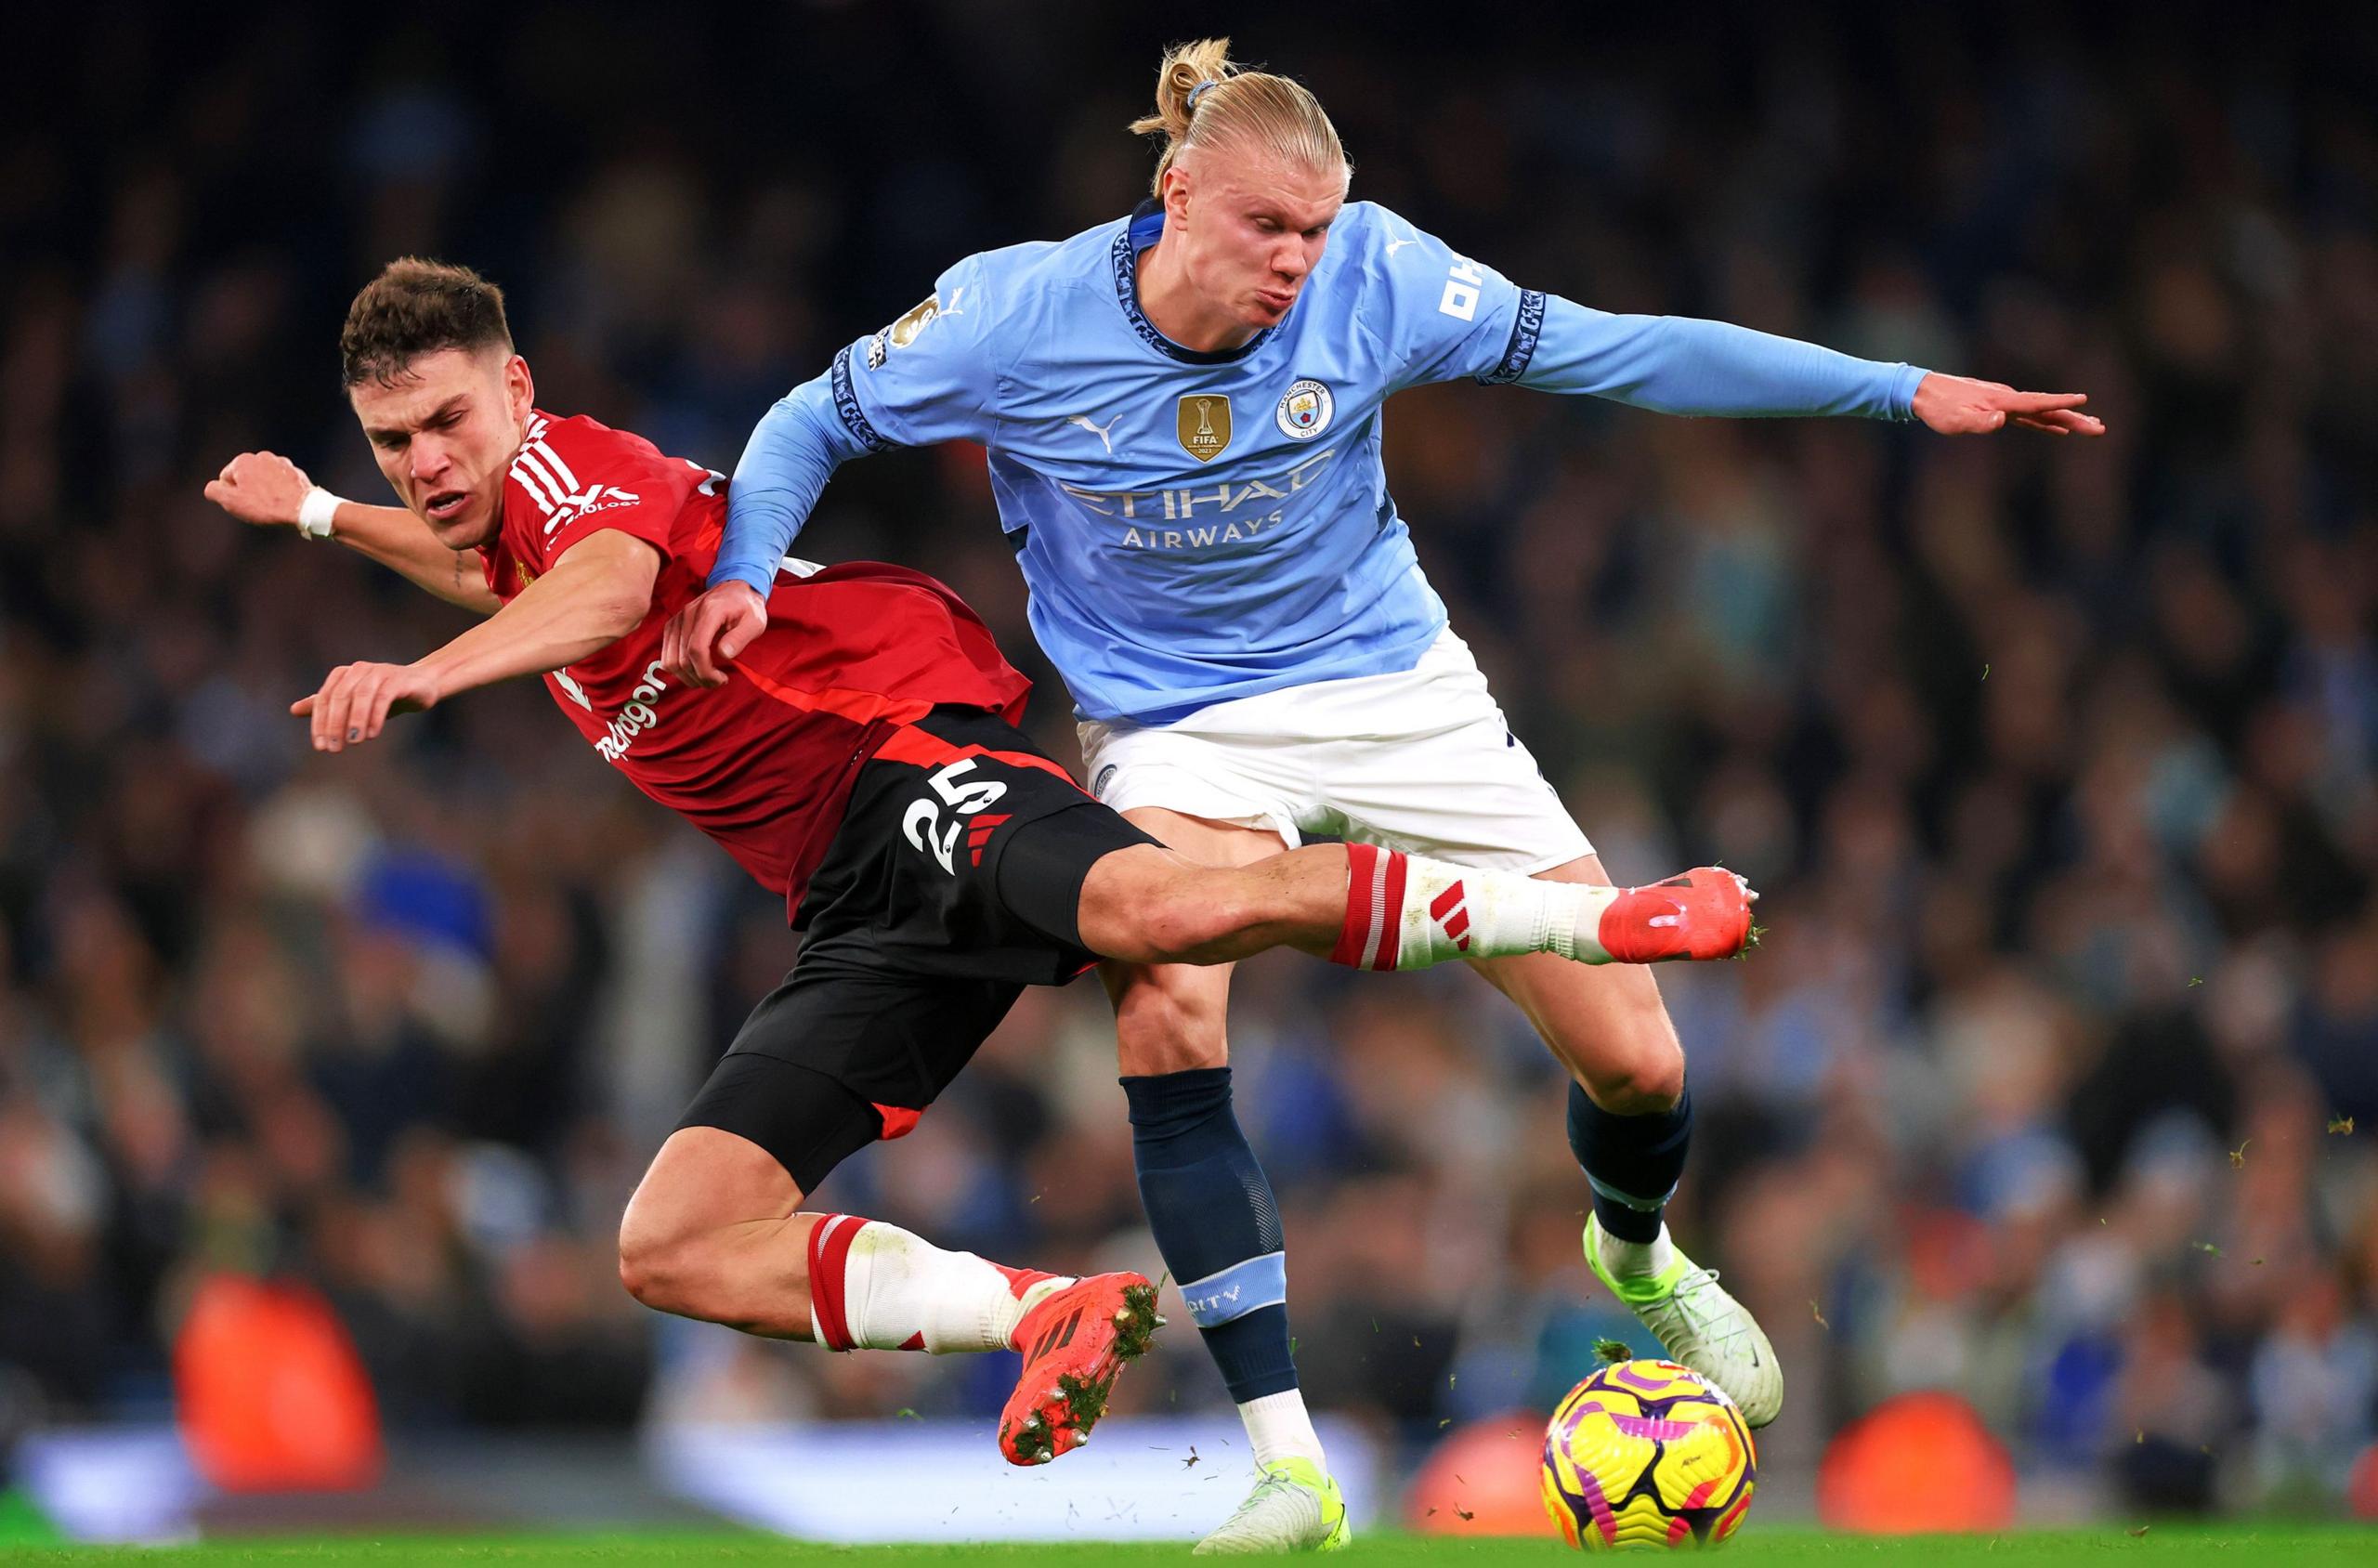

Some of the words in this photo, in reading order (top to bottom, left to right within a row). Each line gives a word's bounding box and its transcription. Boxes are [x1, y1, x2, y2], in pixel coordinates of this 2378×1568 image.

[1280, 382, 1326, 409] MANCHESTER
[1193, 436, 1218, 444] FIFA
[1300, 427, 1317, 437] CITY
[1122, 510, 1282, 550] AIRWAYS
[903, 758, 1007, 876] 25
